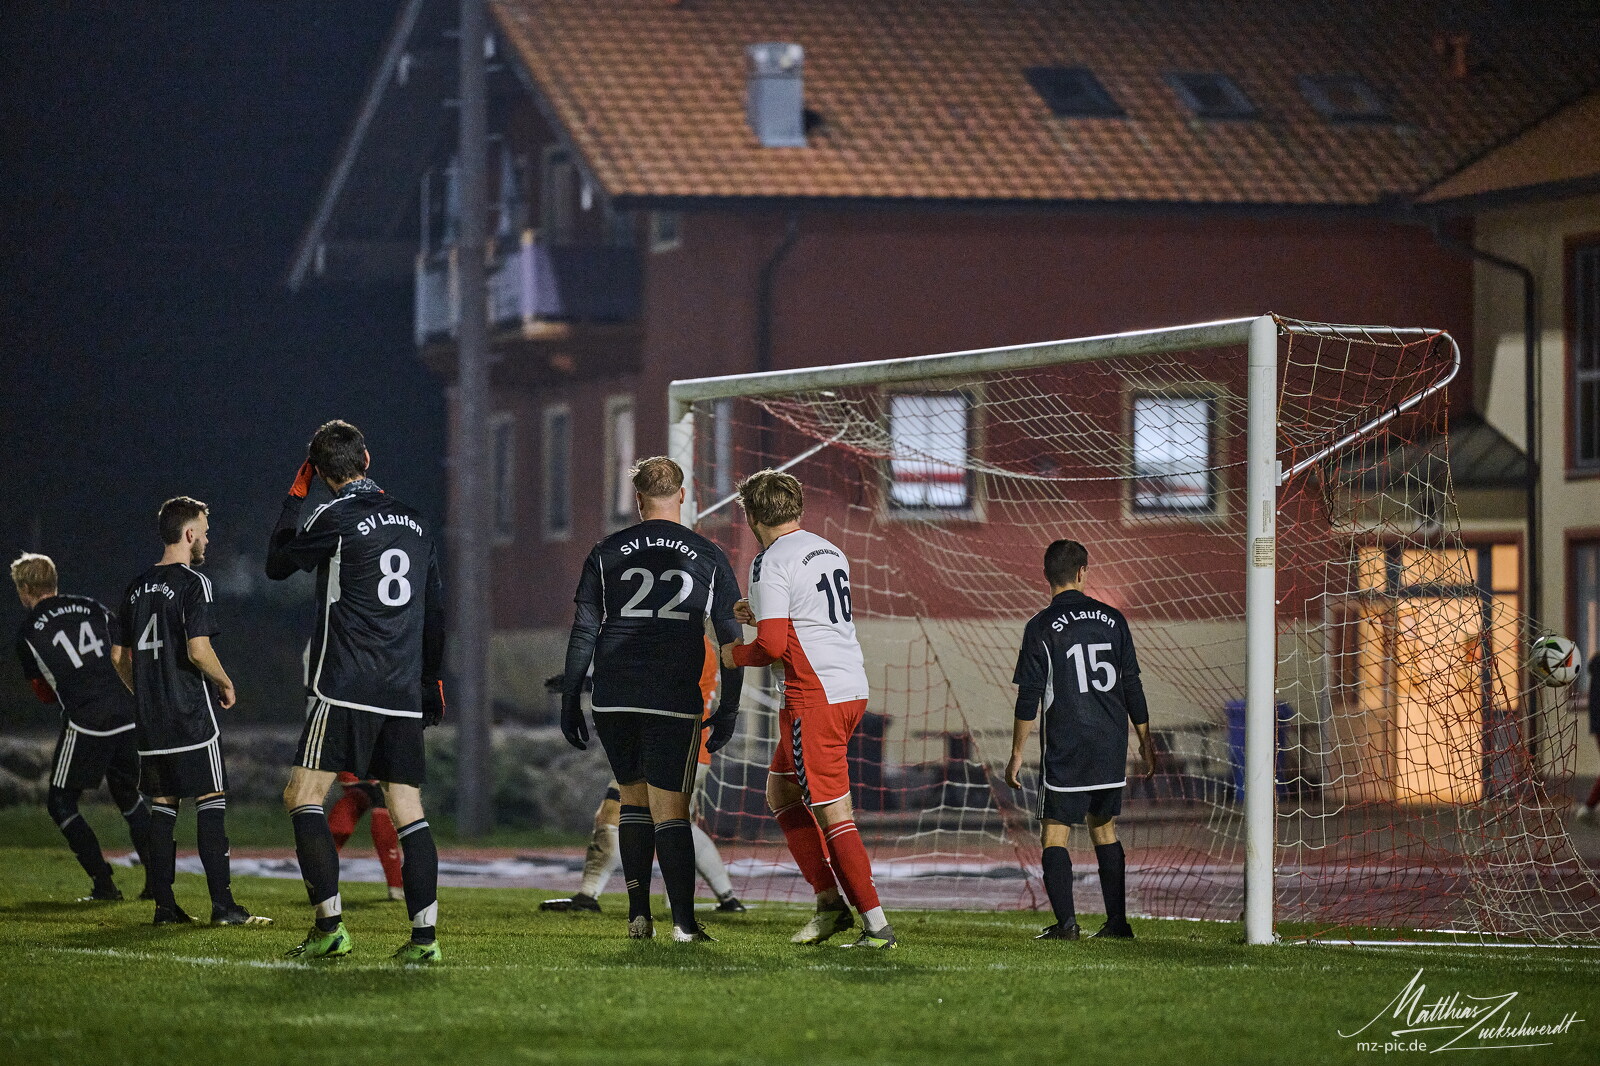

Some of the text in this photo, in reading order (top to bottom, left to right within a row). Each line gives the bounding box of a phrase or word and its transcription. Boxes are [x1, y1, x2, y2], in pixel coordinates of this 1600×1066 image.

[357, 512, 423, 537] SV Laufen
[620, 536, 698, 560] SV Laufen
[130, 582, 175, 604] SV Laufen
[377, 548, 411, 607] 8
[620, 567, 694, 621] 22
[815, 568, 852, 625] 16
[34, 604, 91, 631] SV Laufen
[137, 613, 163, 660] 4
[1051, 610, 1116, 632] SV Laufen
[52, 621, 104, 669] 14
[1066, 642, 1117, 693] 15
